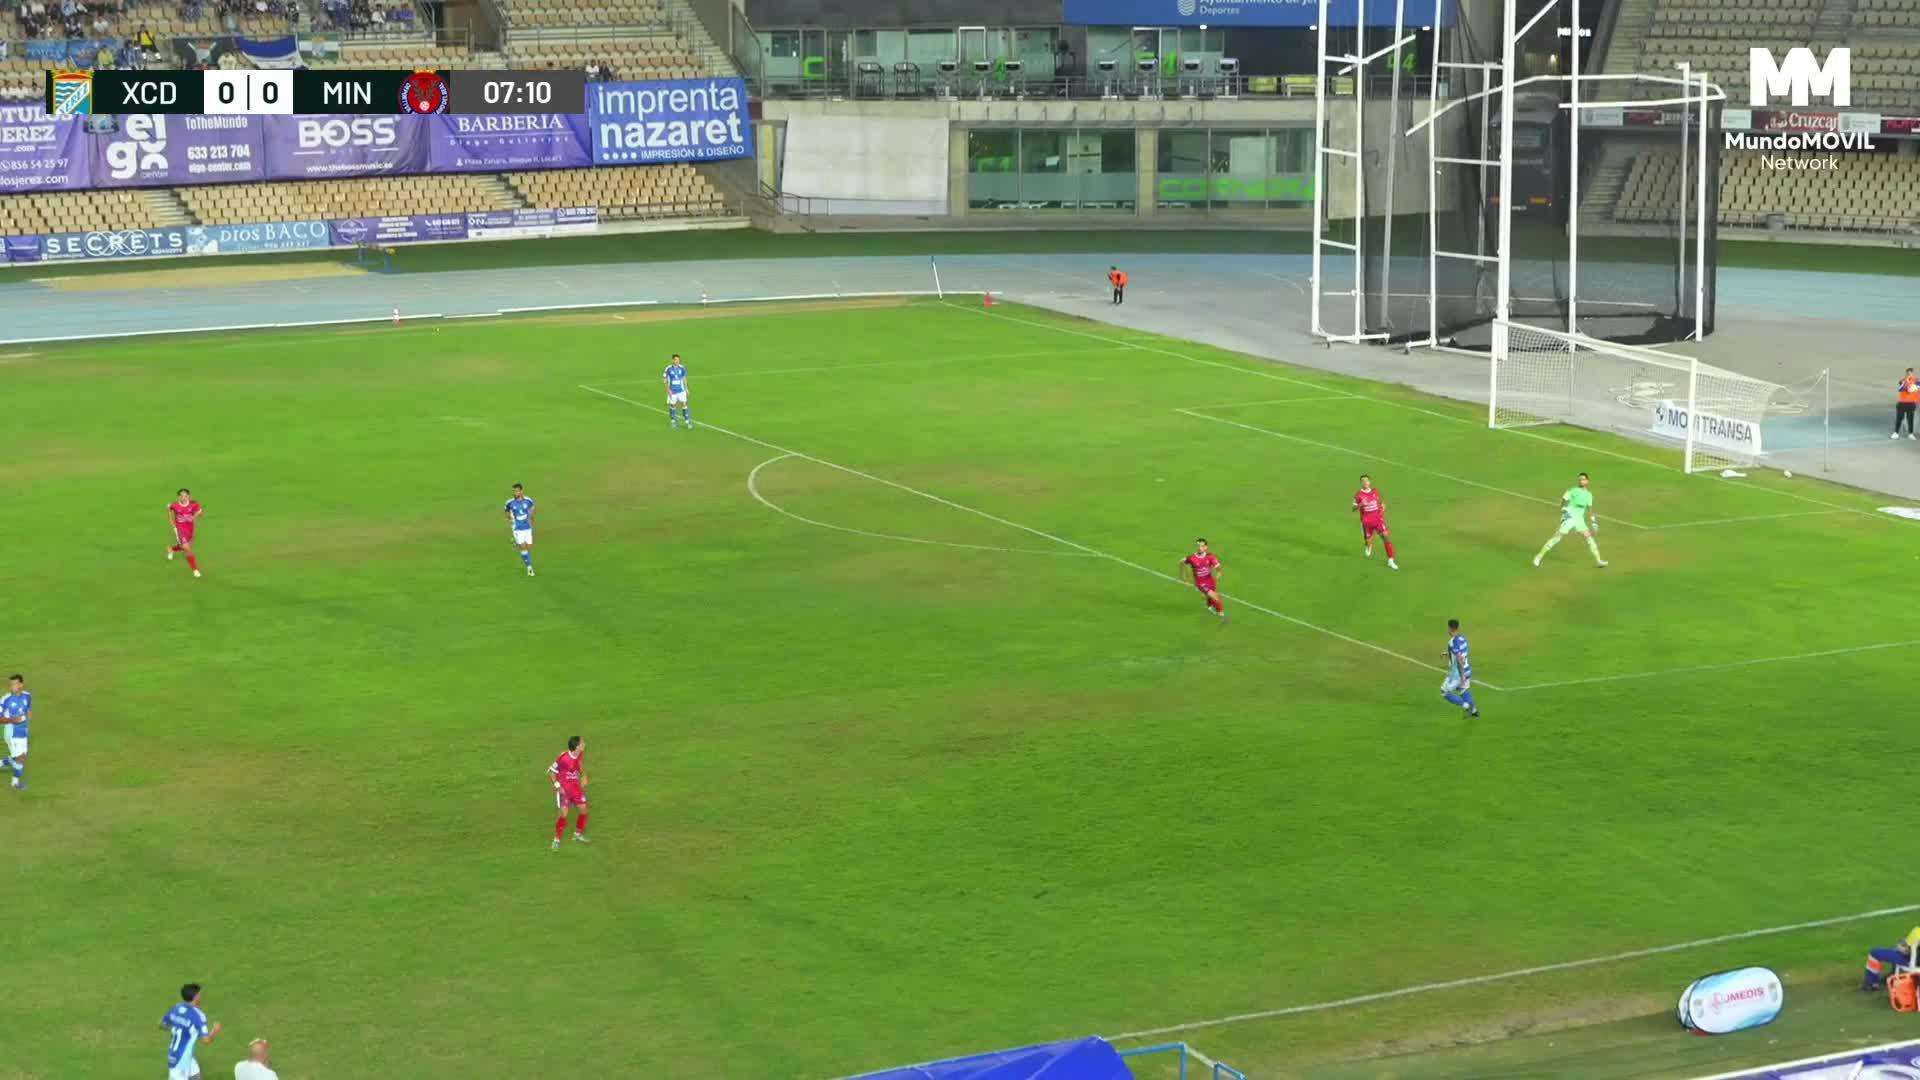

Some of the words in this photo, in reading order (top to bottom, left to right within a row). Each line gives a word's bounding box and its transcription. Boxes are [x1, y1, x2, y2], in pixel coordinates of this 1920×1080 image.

[1200, 5, 1239, 16] Deportes
[598, 81, 740, 121] imprenta
[185, 115, 248, 130] ToTheMundo
[600, 111, 744, 149] nazaret
[298, 118, 397, 148] BOSS
[187, 146, 208, 160] 633
[210, 145, 228, 159] 213
[230, 144, 250, 158] 704
[697, 148, 705, 157] &
[220, 229, 259, 241] DIOS
[265, 221, 326, 240] BACO
[47, 232, 183, 254] SECRETS
